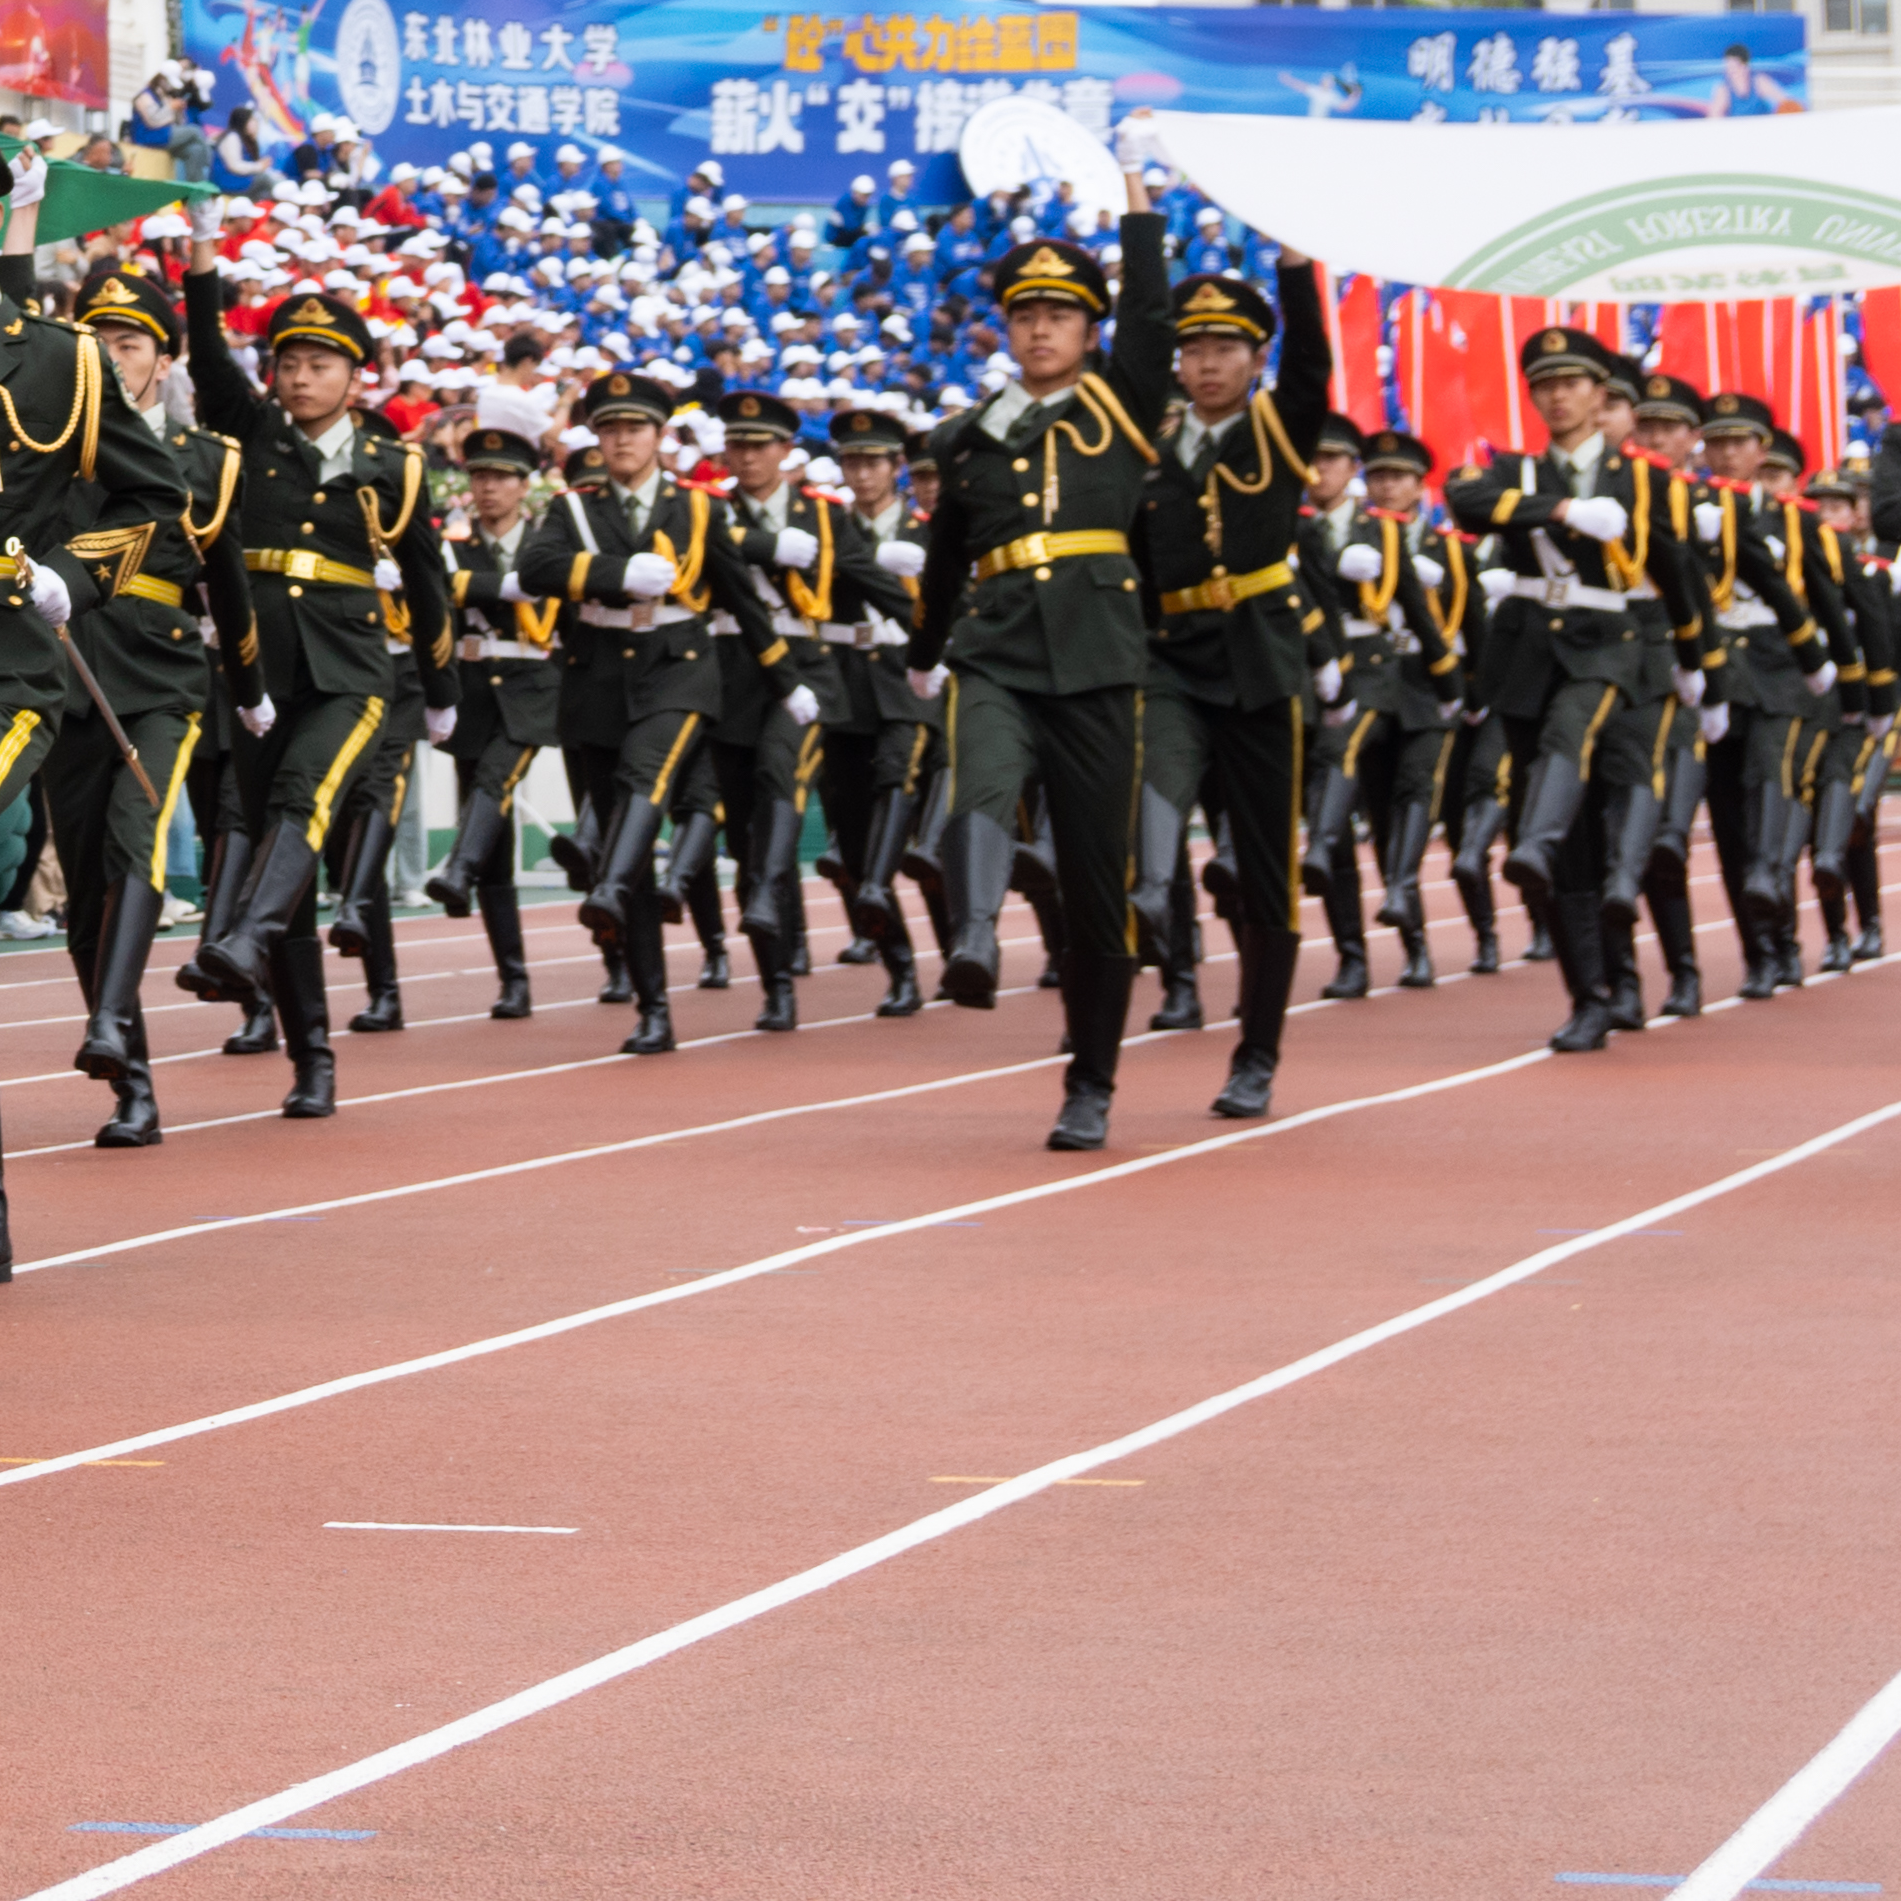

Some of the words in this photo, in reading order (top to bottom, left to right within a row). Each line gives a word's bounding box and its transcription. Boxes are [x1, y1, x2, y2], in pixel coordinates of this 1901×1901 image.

[403, 10, 619, 75] 东北林业大学
[1406, 30, 1653, 97] 明德强基
[403, 74, 622, 136] 土木与交通学院
